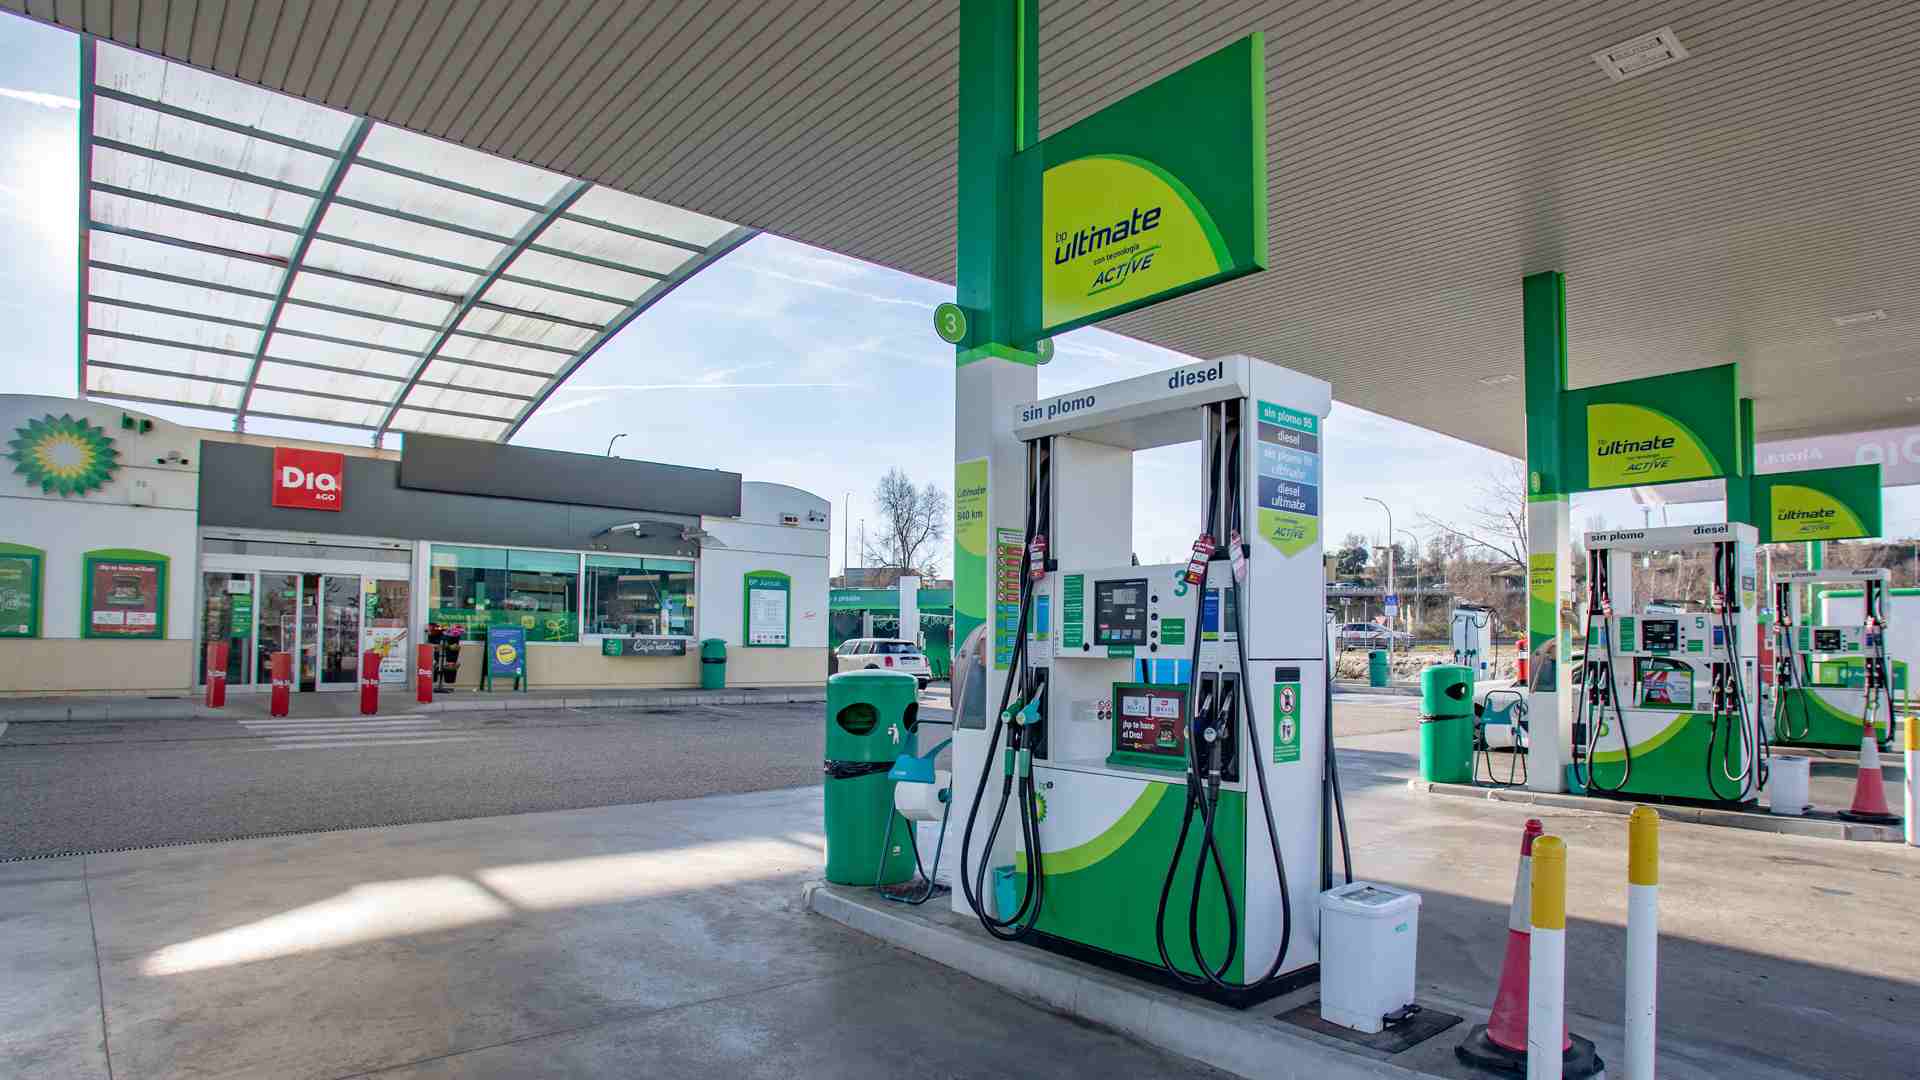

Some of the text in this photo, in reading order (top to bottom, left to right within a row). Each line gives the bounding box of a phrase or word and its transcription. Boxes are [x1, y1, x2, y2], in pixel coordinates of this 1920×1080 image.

[1055, 207, 1162, 265] ultimate
[1092, 253, 1154, 288] ACTIVE
[944, 313, 957, 334] 3
[1168, 361, 1223, 389] diesel
[1022, 395, 1096, 422] sin plomo
[1264, 408, 1276, 420] sin
[1277, 411, 1302, 426] plomo
[121, 412, 153, 435] bp
[1278, 430, 1300, 445] diesel
[1597, 435, 1676, 457] ultimate
[282, 466, 338, 491] Dia
[1278, 482, 1300, 496] diesel
[1271, 495, 1306, 511] ultimate
[1777, 507, 1836, 520] ultimate
[1591, 525, 1728, 542] sin plomo diesel
[1173, 570, 1188, 597] 3
[1696, 617, 1704, 629] 5
